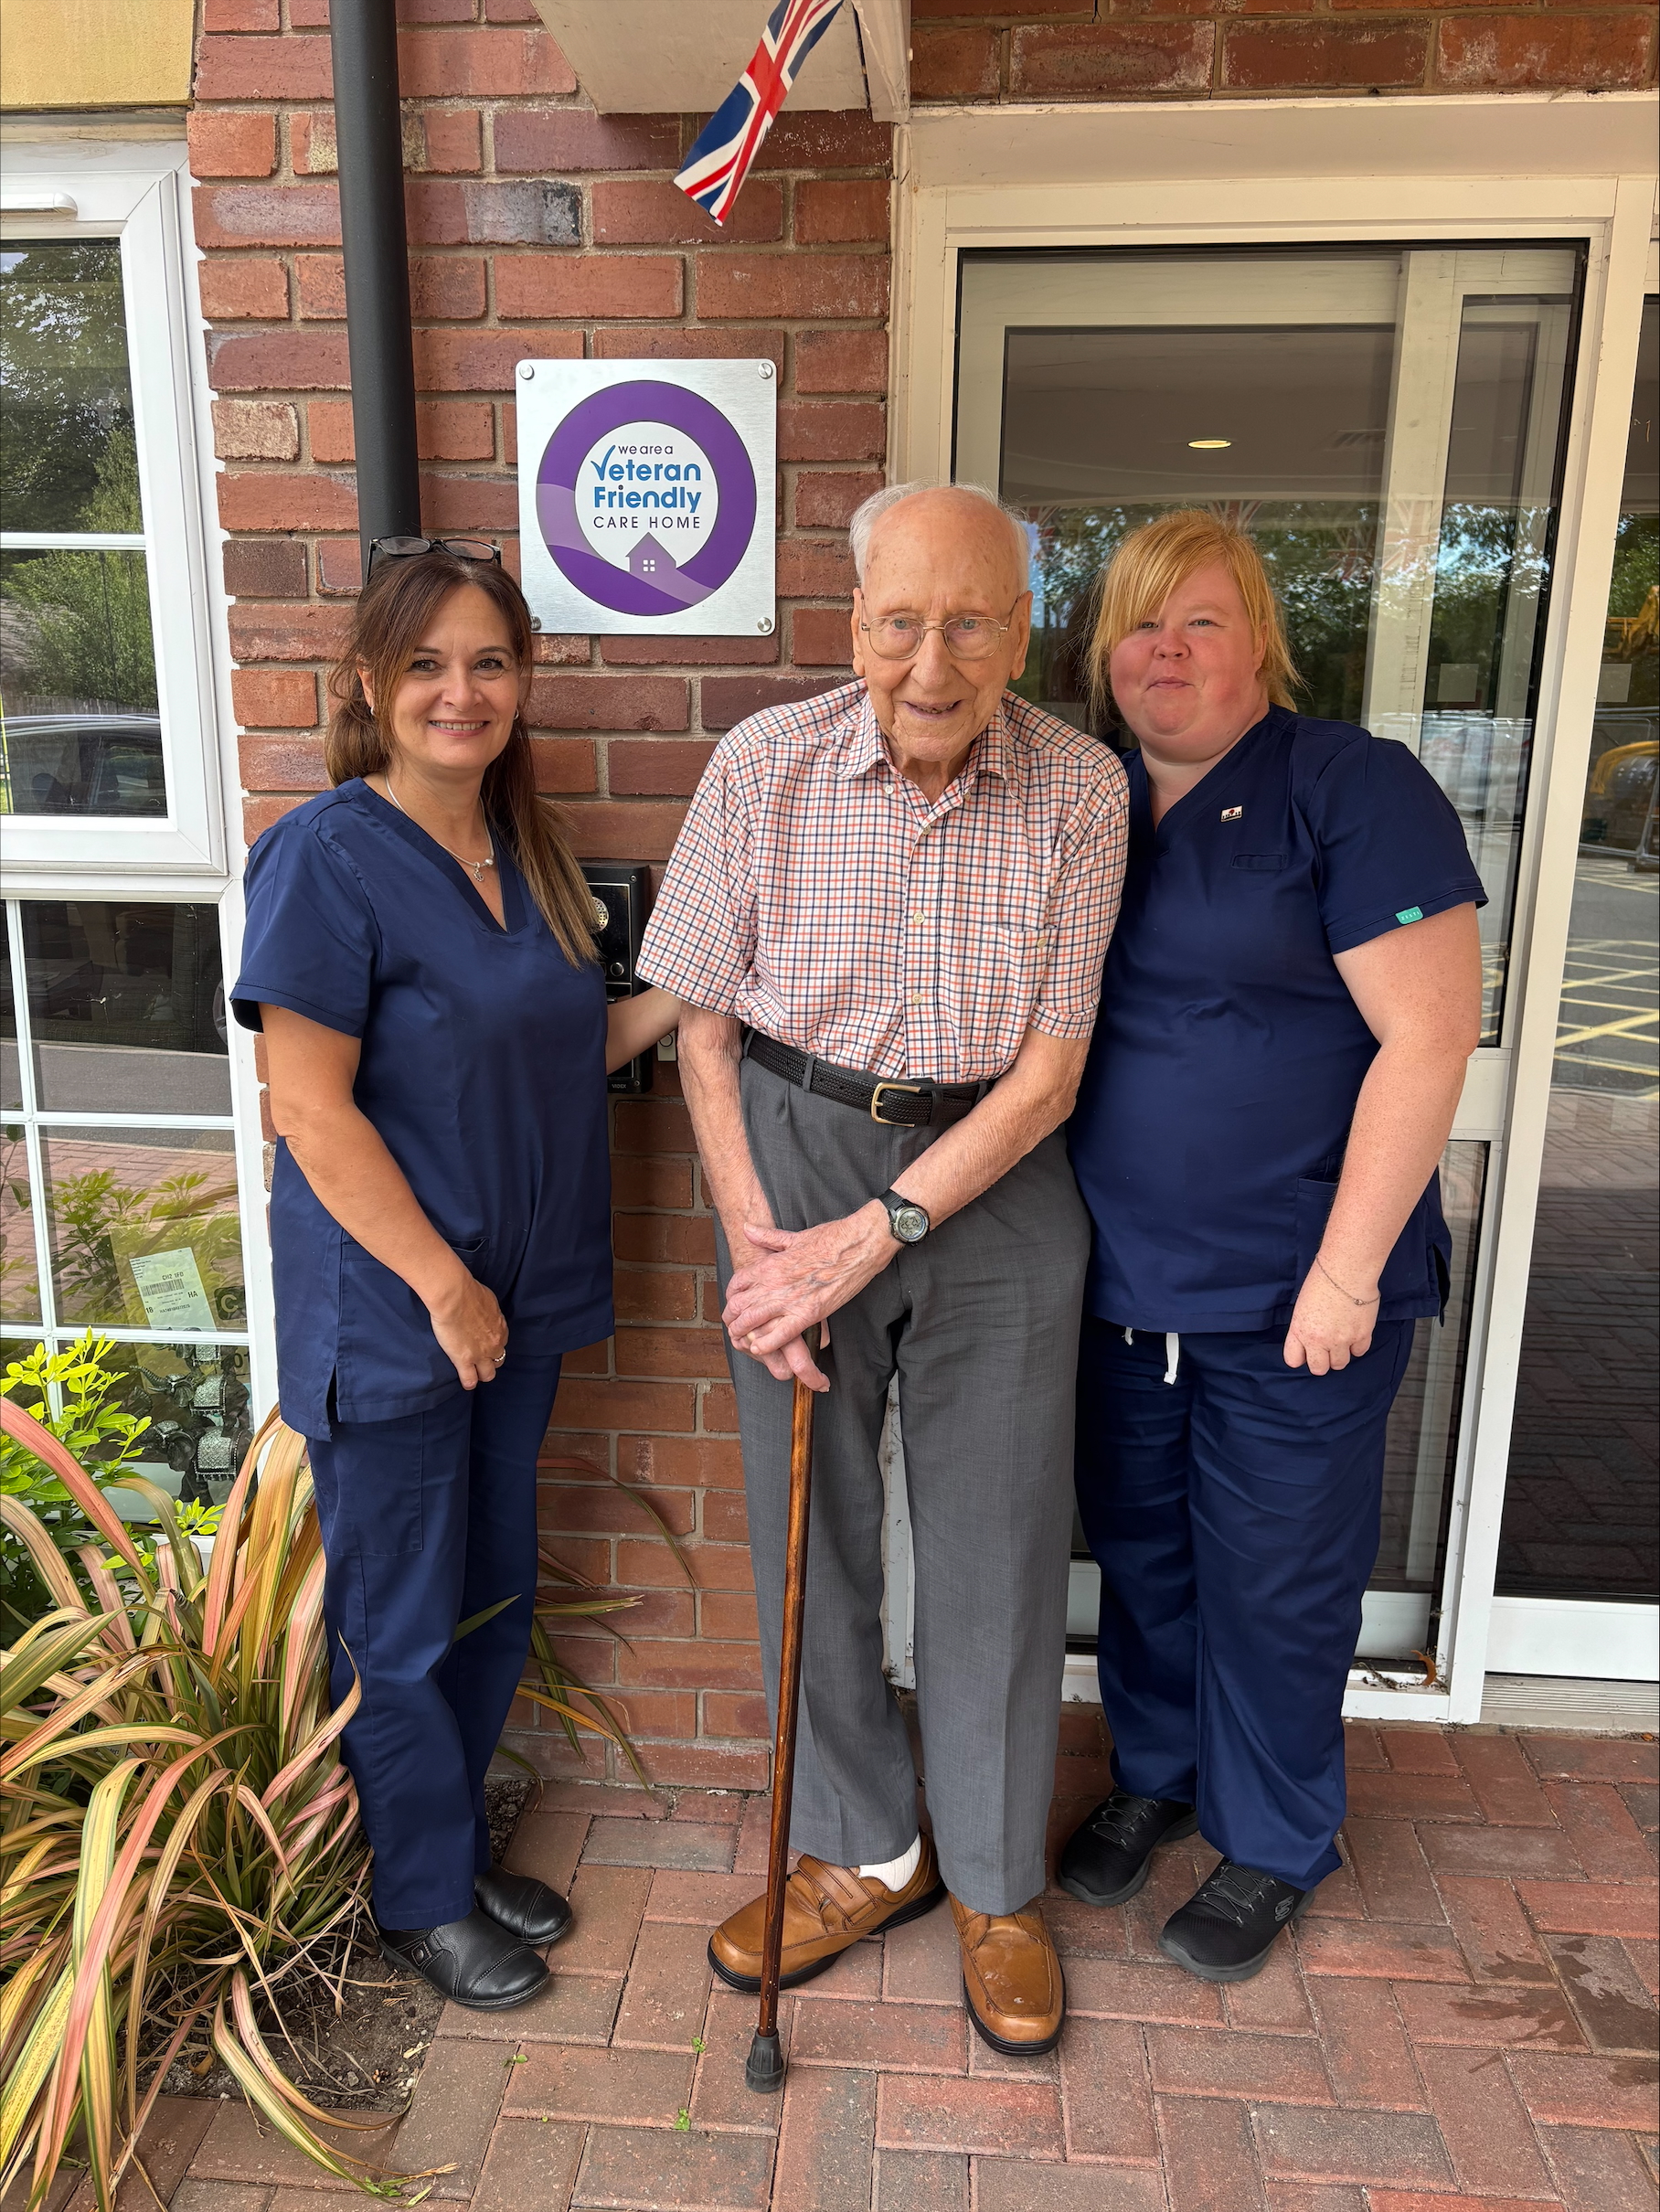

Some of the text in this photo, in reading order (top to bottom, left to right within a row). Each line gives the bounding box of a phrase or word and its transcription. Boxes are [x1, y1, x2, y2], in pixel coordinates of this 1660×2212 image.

[618, 445, 674, 454] we are a
[591, 445, 701, 481] Veteran
[594, 484, 702, 513] Friendly
[593, 516, 700, 528] CARE HOME
[145, 1306, 154, 1314] 18
